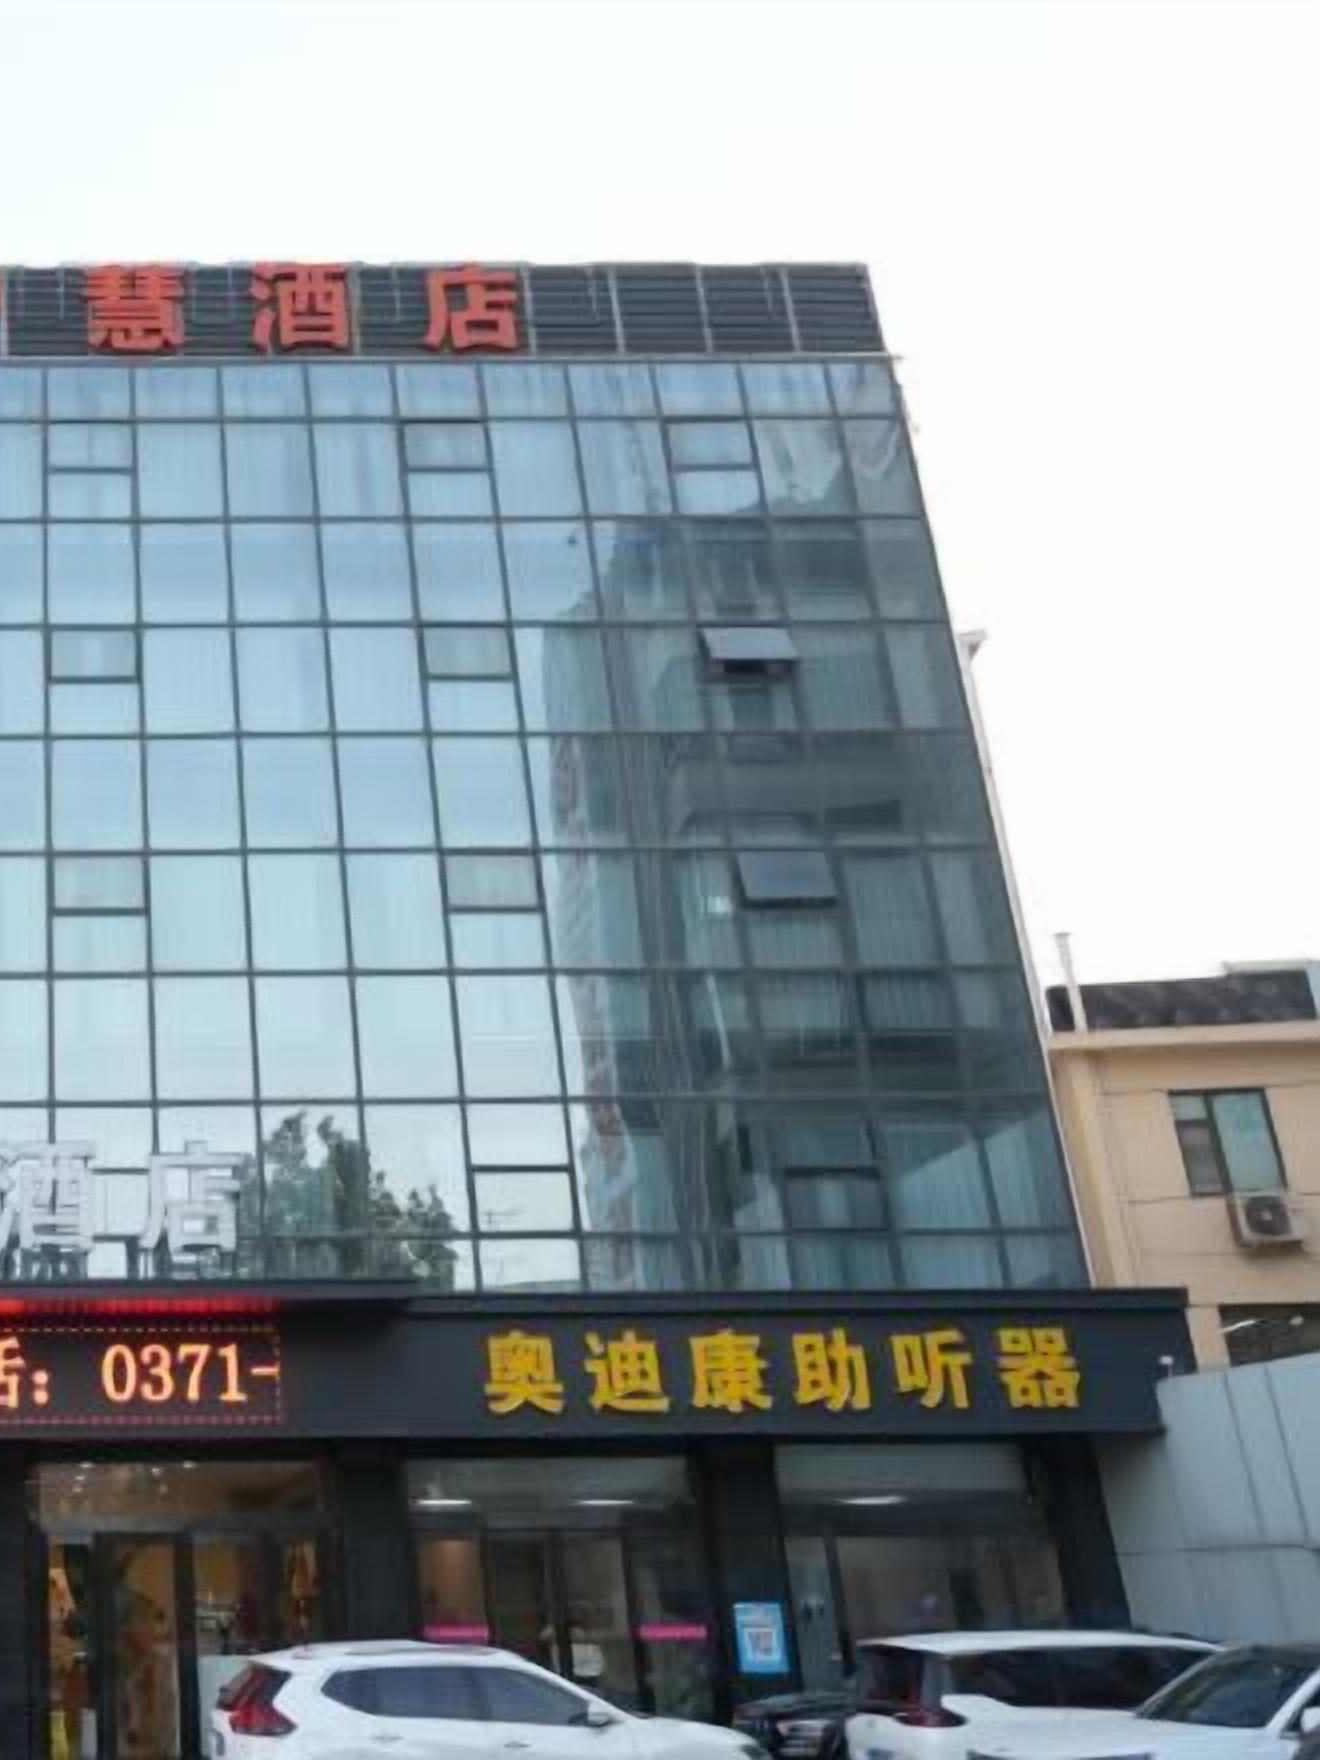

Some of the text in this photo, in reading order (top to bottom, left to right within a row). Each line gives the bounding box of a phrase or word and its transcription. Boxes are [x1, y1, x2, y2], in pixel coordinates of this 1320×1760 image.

[484, 1327, 1080, 1413] 奥迪康助听器
